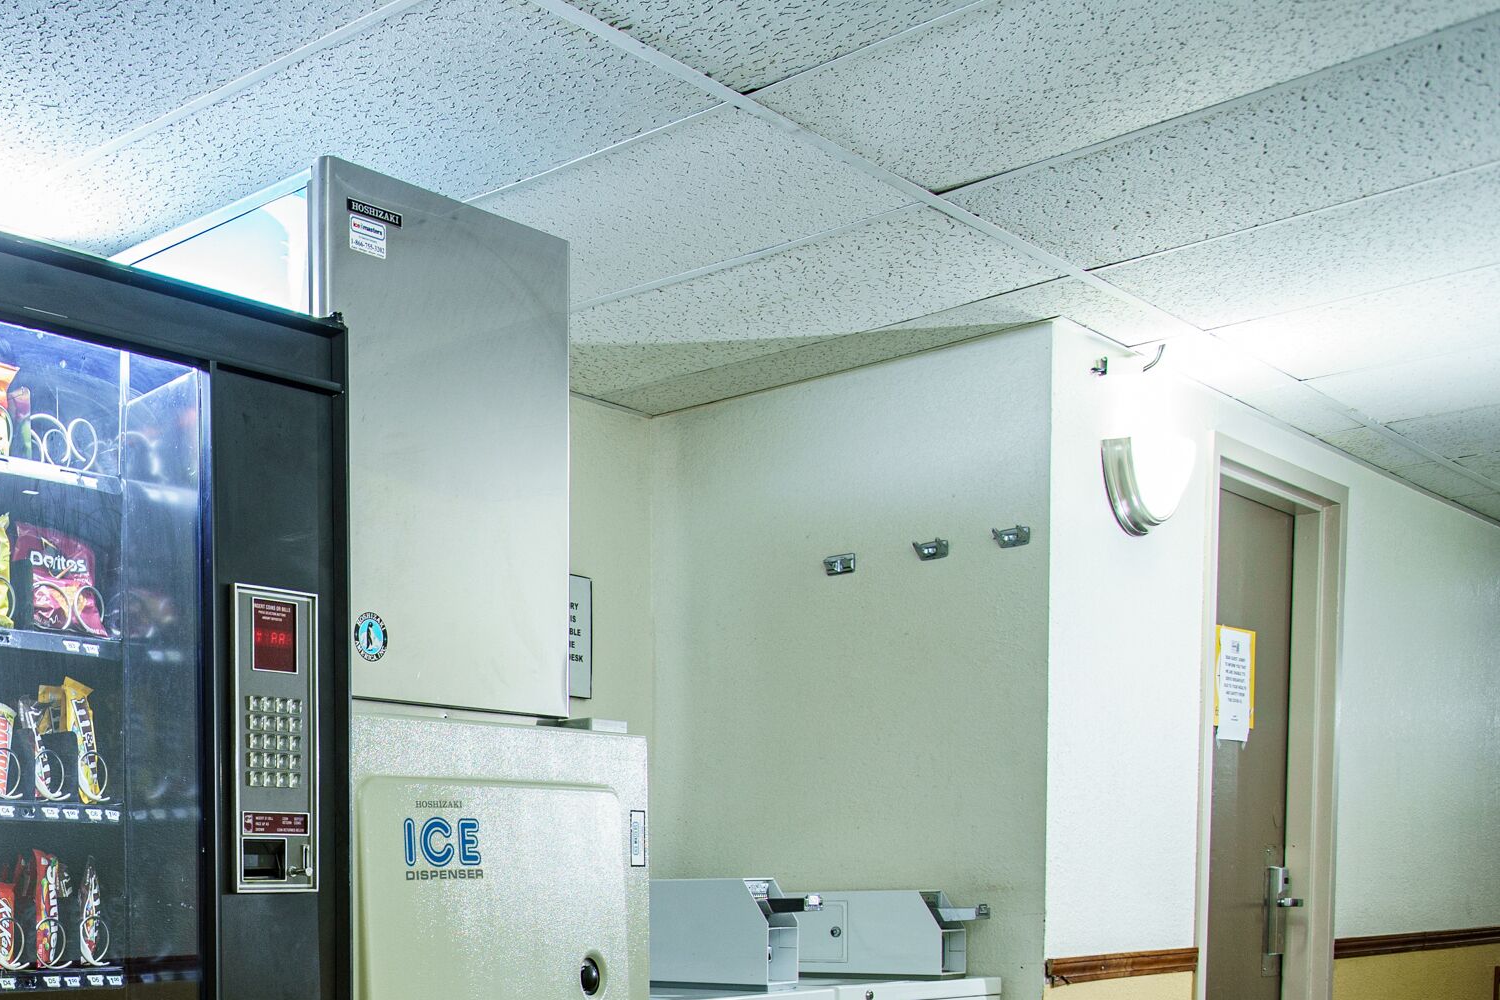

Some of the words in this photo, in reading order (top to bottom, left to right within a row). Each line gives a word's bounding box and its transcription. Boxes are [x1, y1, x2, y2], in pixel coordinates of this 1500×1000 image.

[351, 201, 400, 224] HOSHIZAKI
[30, 550, 87, 572] Doritos
[416, 800, 462, 808] HOSHIZAKI
[404, 816, 482, 868] ICE
[406, 869, 484, 880] DISPENSER
